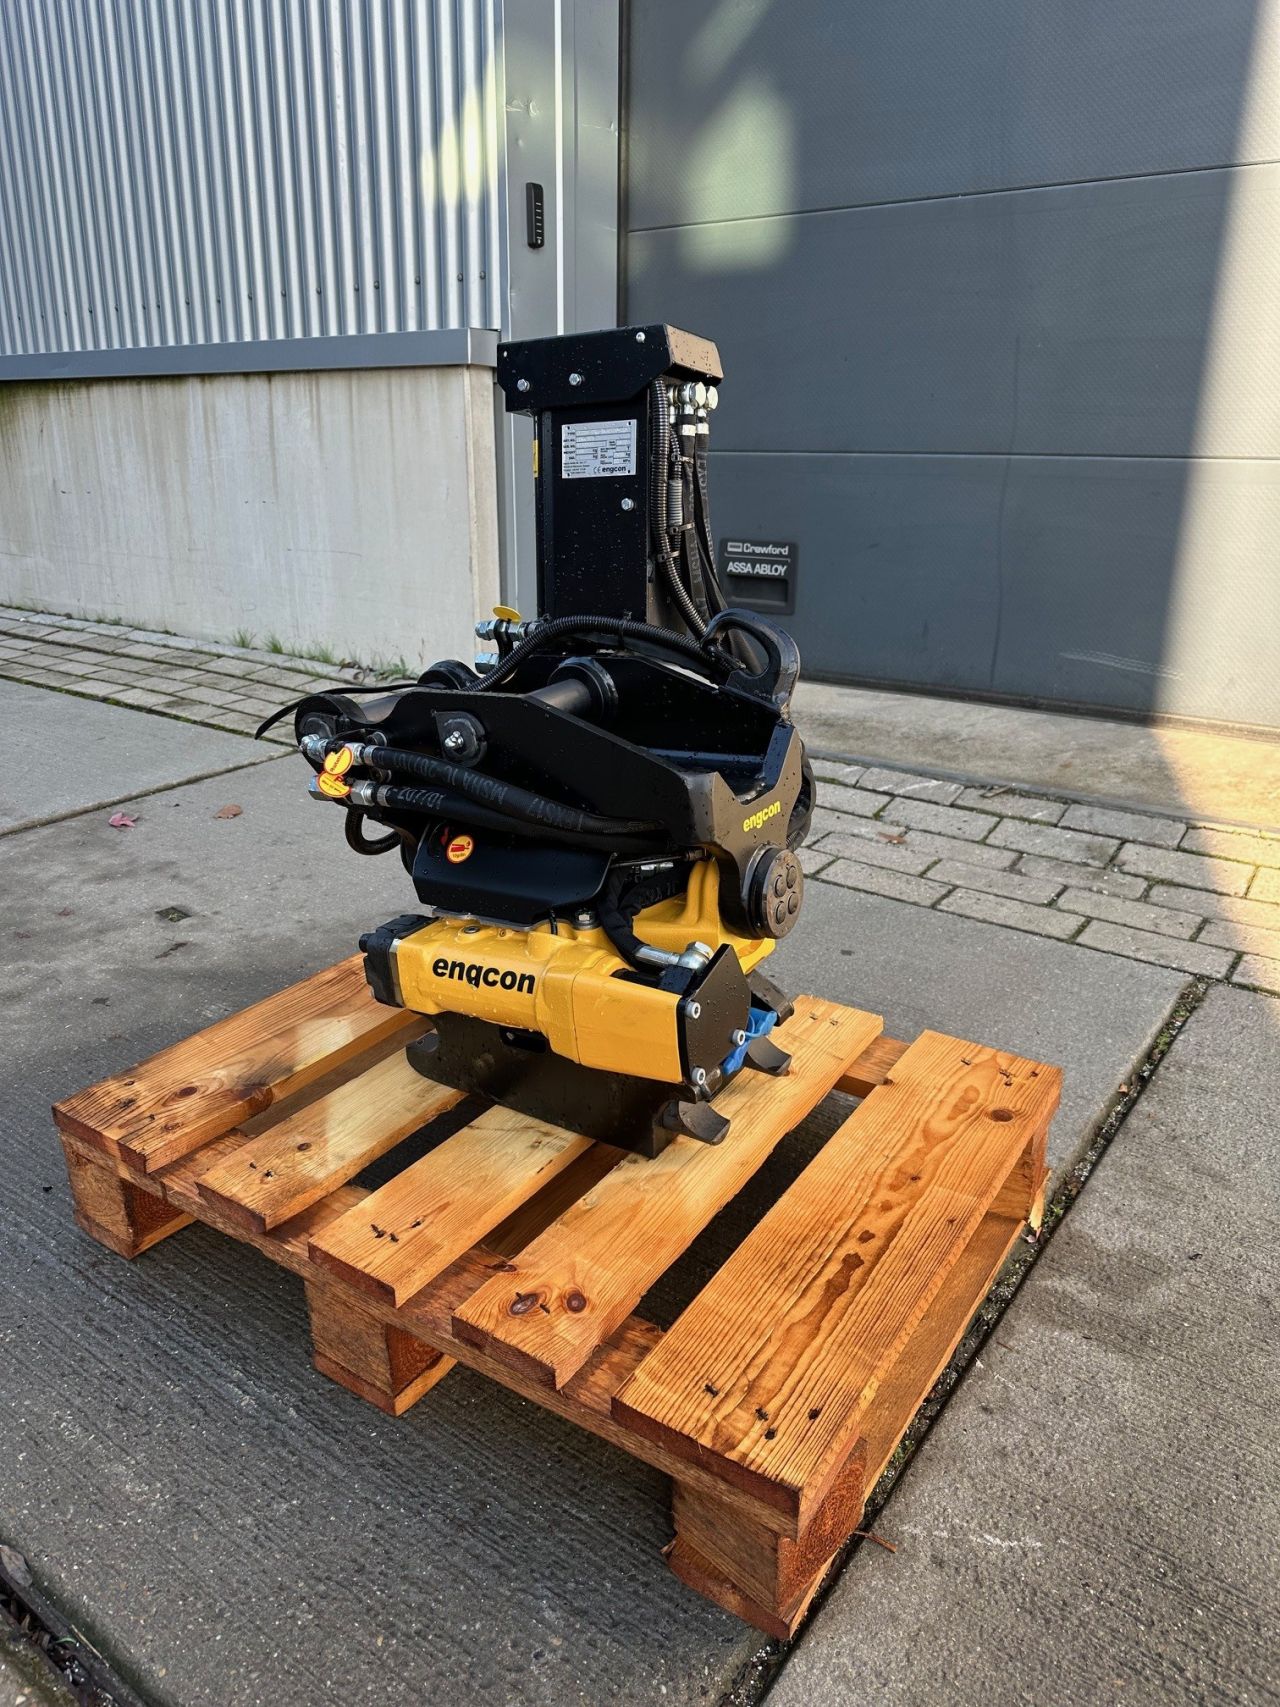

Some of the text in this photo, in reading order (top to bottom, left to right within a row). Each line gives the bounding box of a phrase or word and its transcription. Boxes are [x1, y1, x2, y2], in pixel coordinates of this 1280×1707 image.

[743, 543, 789, 555] Crawford
[726, 561, 788, 576] ASSA ABLOY
[743, 800, 781, 833] engcon
